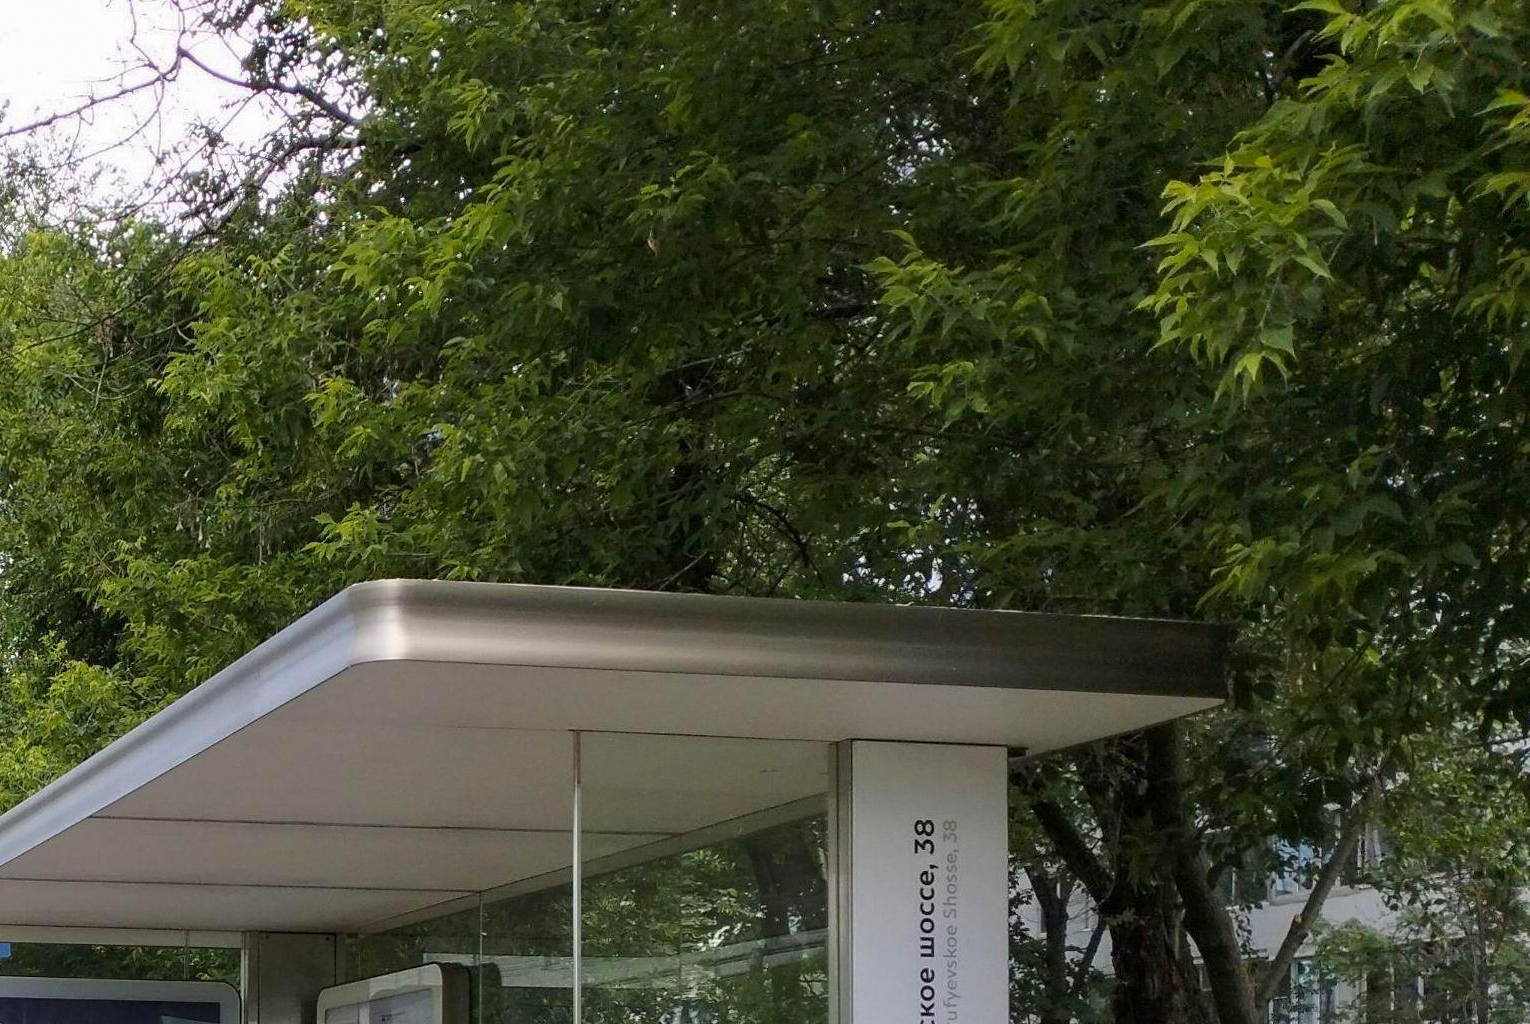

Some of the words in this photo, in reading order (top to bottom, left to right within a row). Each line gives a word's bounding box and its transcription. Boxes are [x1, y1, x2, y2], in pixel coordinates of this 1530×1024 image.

[913, 818, 936, 856] 38
[942, 819, 958, 843] 38
[942, 848, 960, 919] Shosse,
[918, 864, 939, 958] шоссе,
